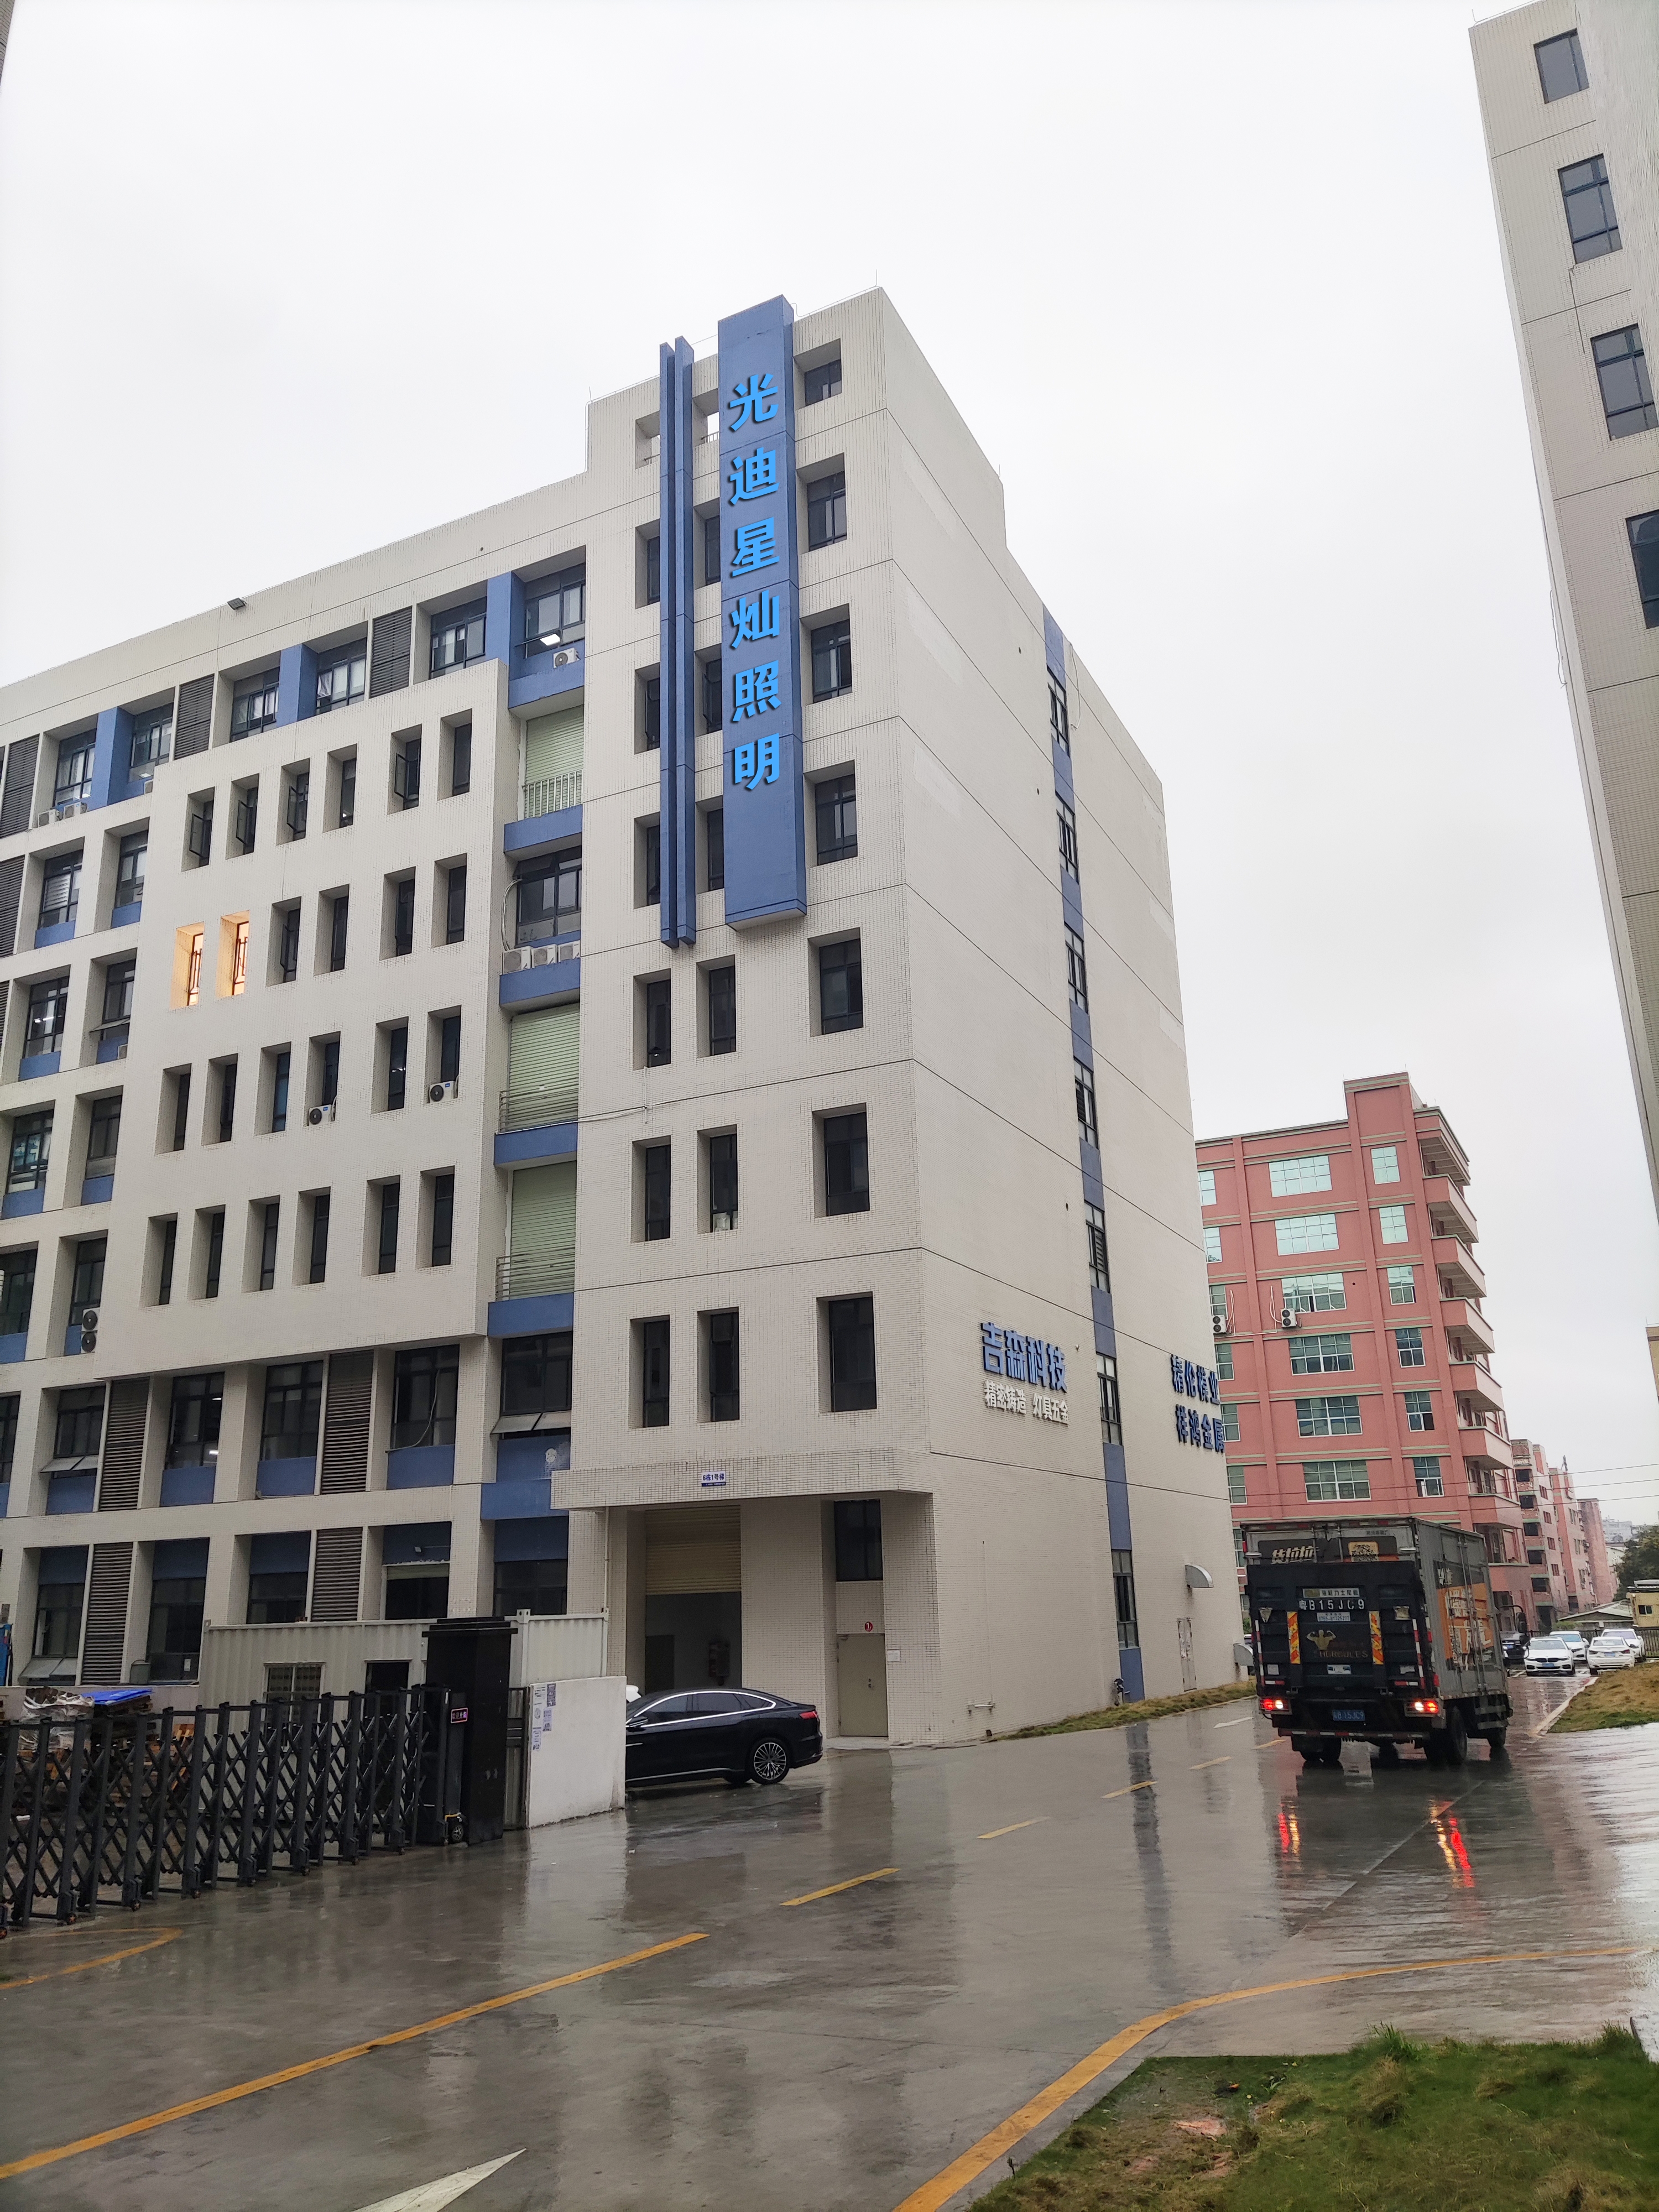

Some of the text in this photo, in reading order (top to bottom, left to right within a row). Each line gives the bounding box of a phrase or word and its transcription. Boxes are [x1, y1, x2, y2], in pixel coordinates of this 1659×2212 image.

[729, 372, 781, 790] 光迪星灿照明
[1271, 1546, 1319, 1564] 货拉拉
